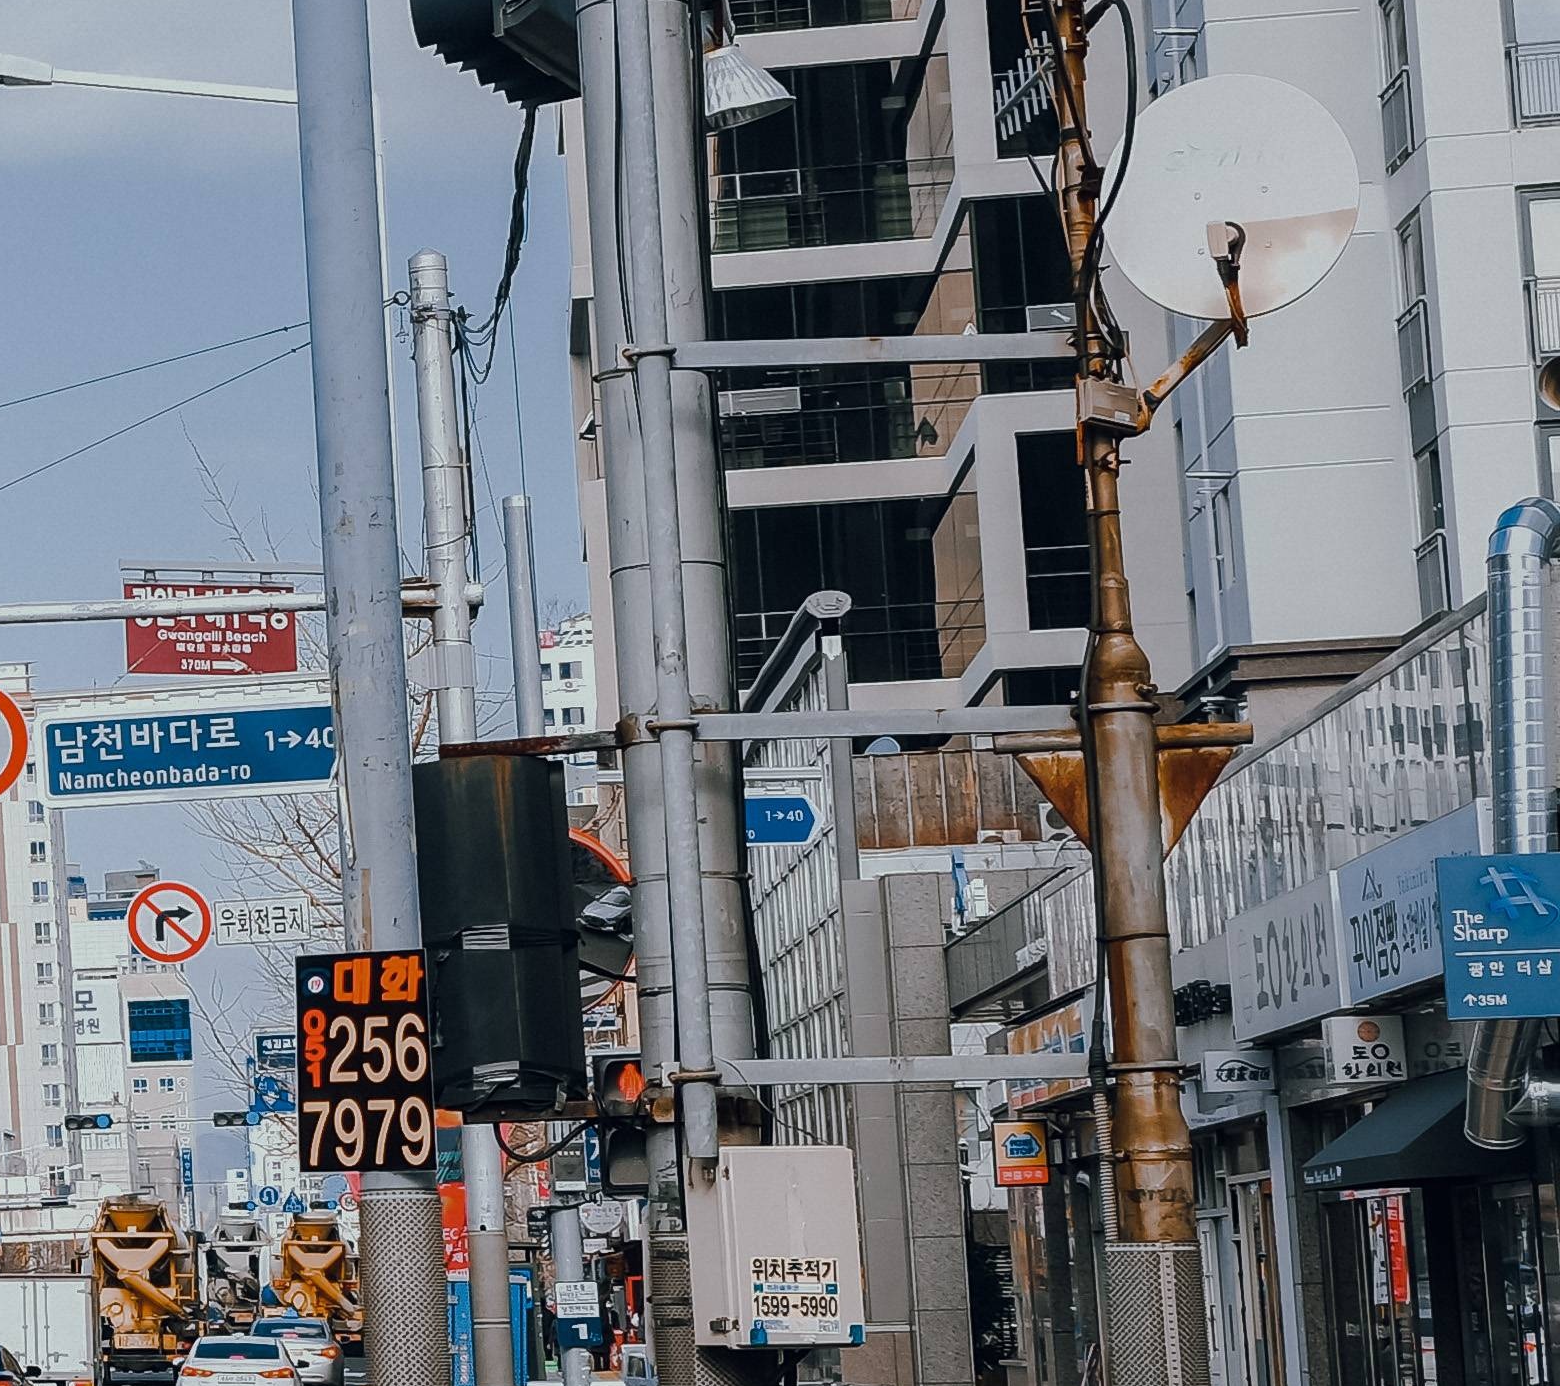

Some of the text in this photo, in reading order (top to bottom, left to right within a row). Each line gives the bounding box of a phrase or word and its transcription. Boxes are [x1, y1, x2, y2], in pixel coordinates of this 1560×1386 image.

[157, 629, 268, 644] Gwangalli Beach
[54, 717, 240, 764] 남천바다로
[264, 730, 275, 752] 1
[59, 763, 251, 791] Namcheonbada-ro
[219, 903, 306, 937] 우회전금지
[1452, 910, 1484, 925] The
[1453, 925, 1509, 944] Sharp
[1468, 958, 1553, 977] 광안 더샵
[333, 954, 424, 1005] 대화
[1477, 994, 1507, 1007] 35M
[302, 1009, 427, 1088] 051 256
[1341, 1061, 1405, 1080] 한의원
[302, 1095, 431, 1167] 7979
[751, 1258, 837, 1283] 위치추적기
[753, 1295, 838, 1317] 1599-5990
[571, 1323, 588, 1340] 1
